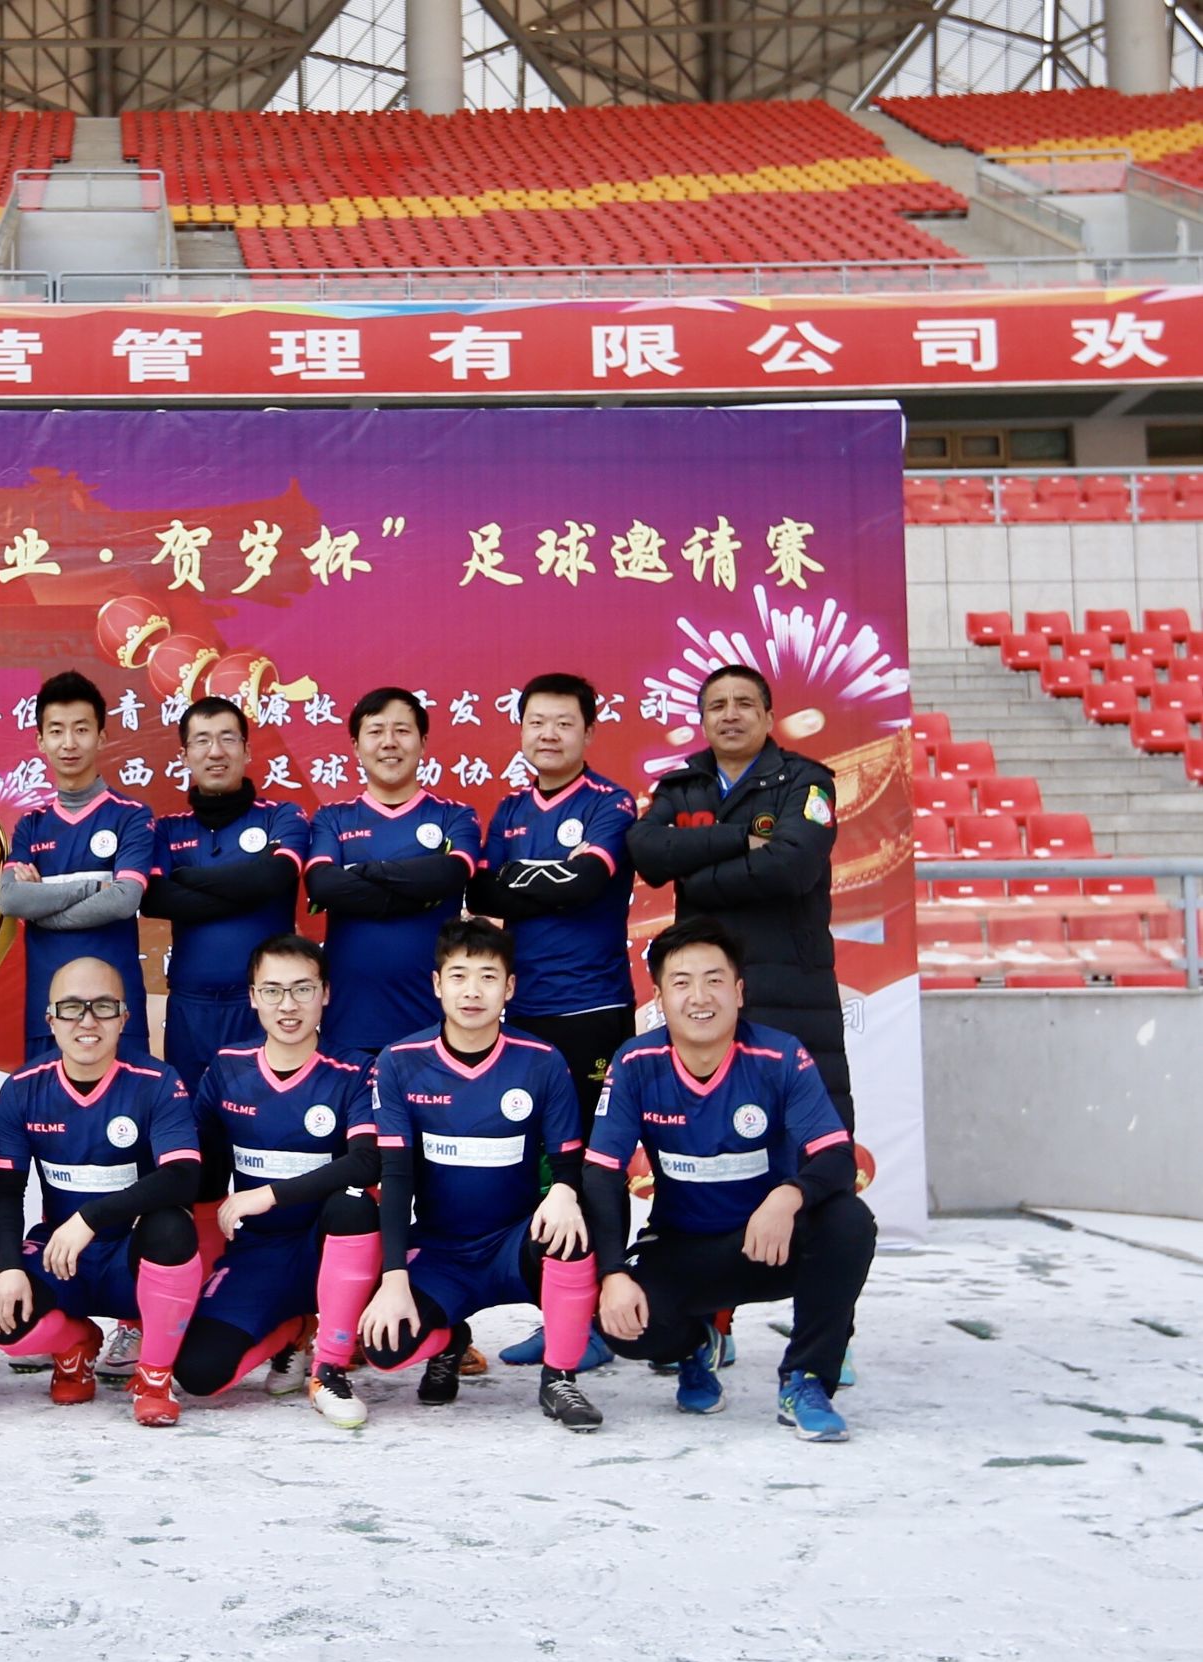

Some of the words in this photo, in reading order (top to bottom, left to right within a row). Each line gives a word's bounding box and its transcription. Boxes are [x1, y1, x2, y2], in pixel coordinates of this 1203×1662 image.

[338, 829, 372, 842] ELME
[30, 841, 55, 853] ELME
[170, 839, 197, 851] ELME
[407, 1093, 452, 1105] KELME
[222, 1101, 257, 1116] KELME
[643, 1112, 686, 1125] KELME
[26, 1122, 66, 1133] KELME
